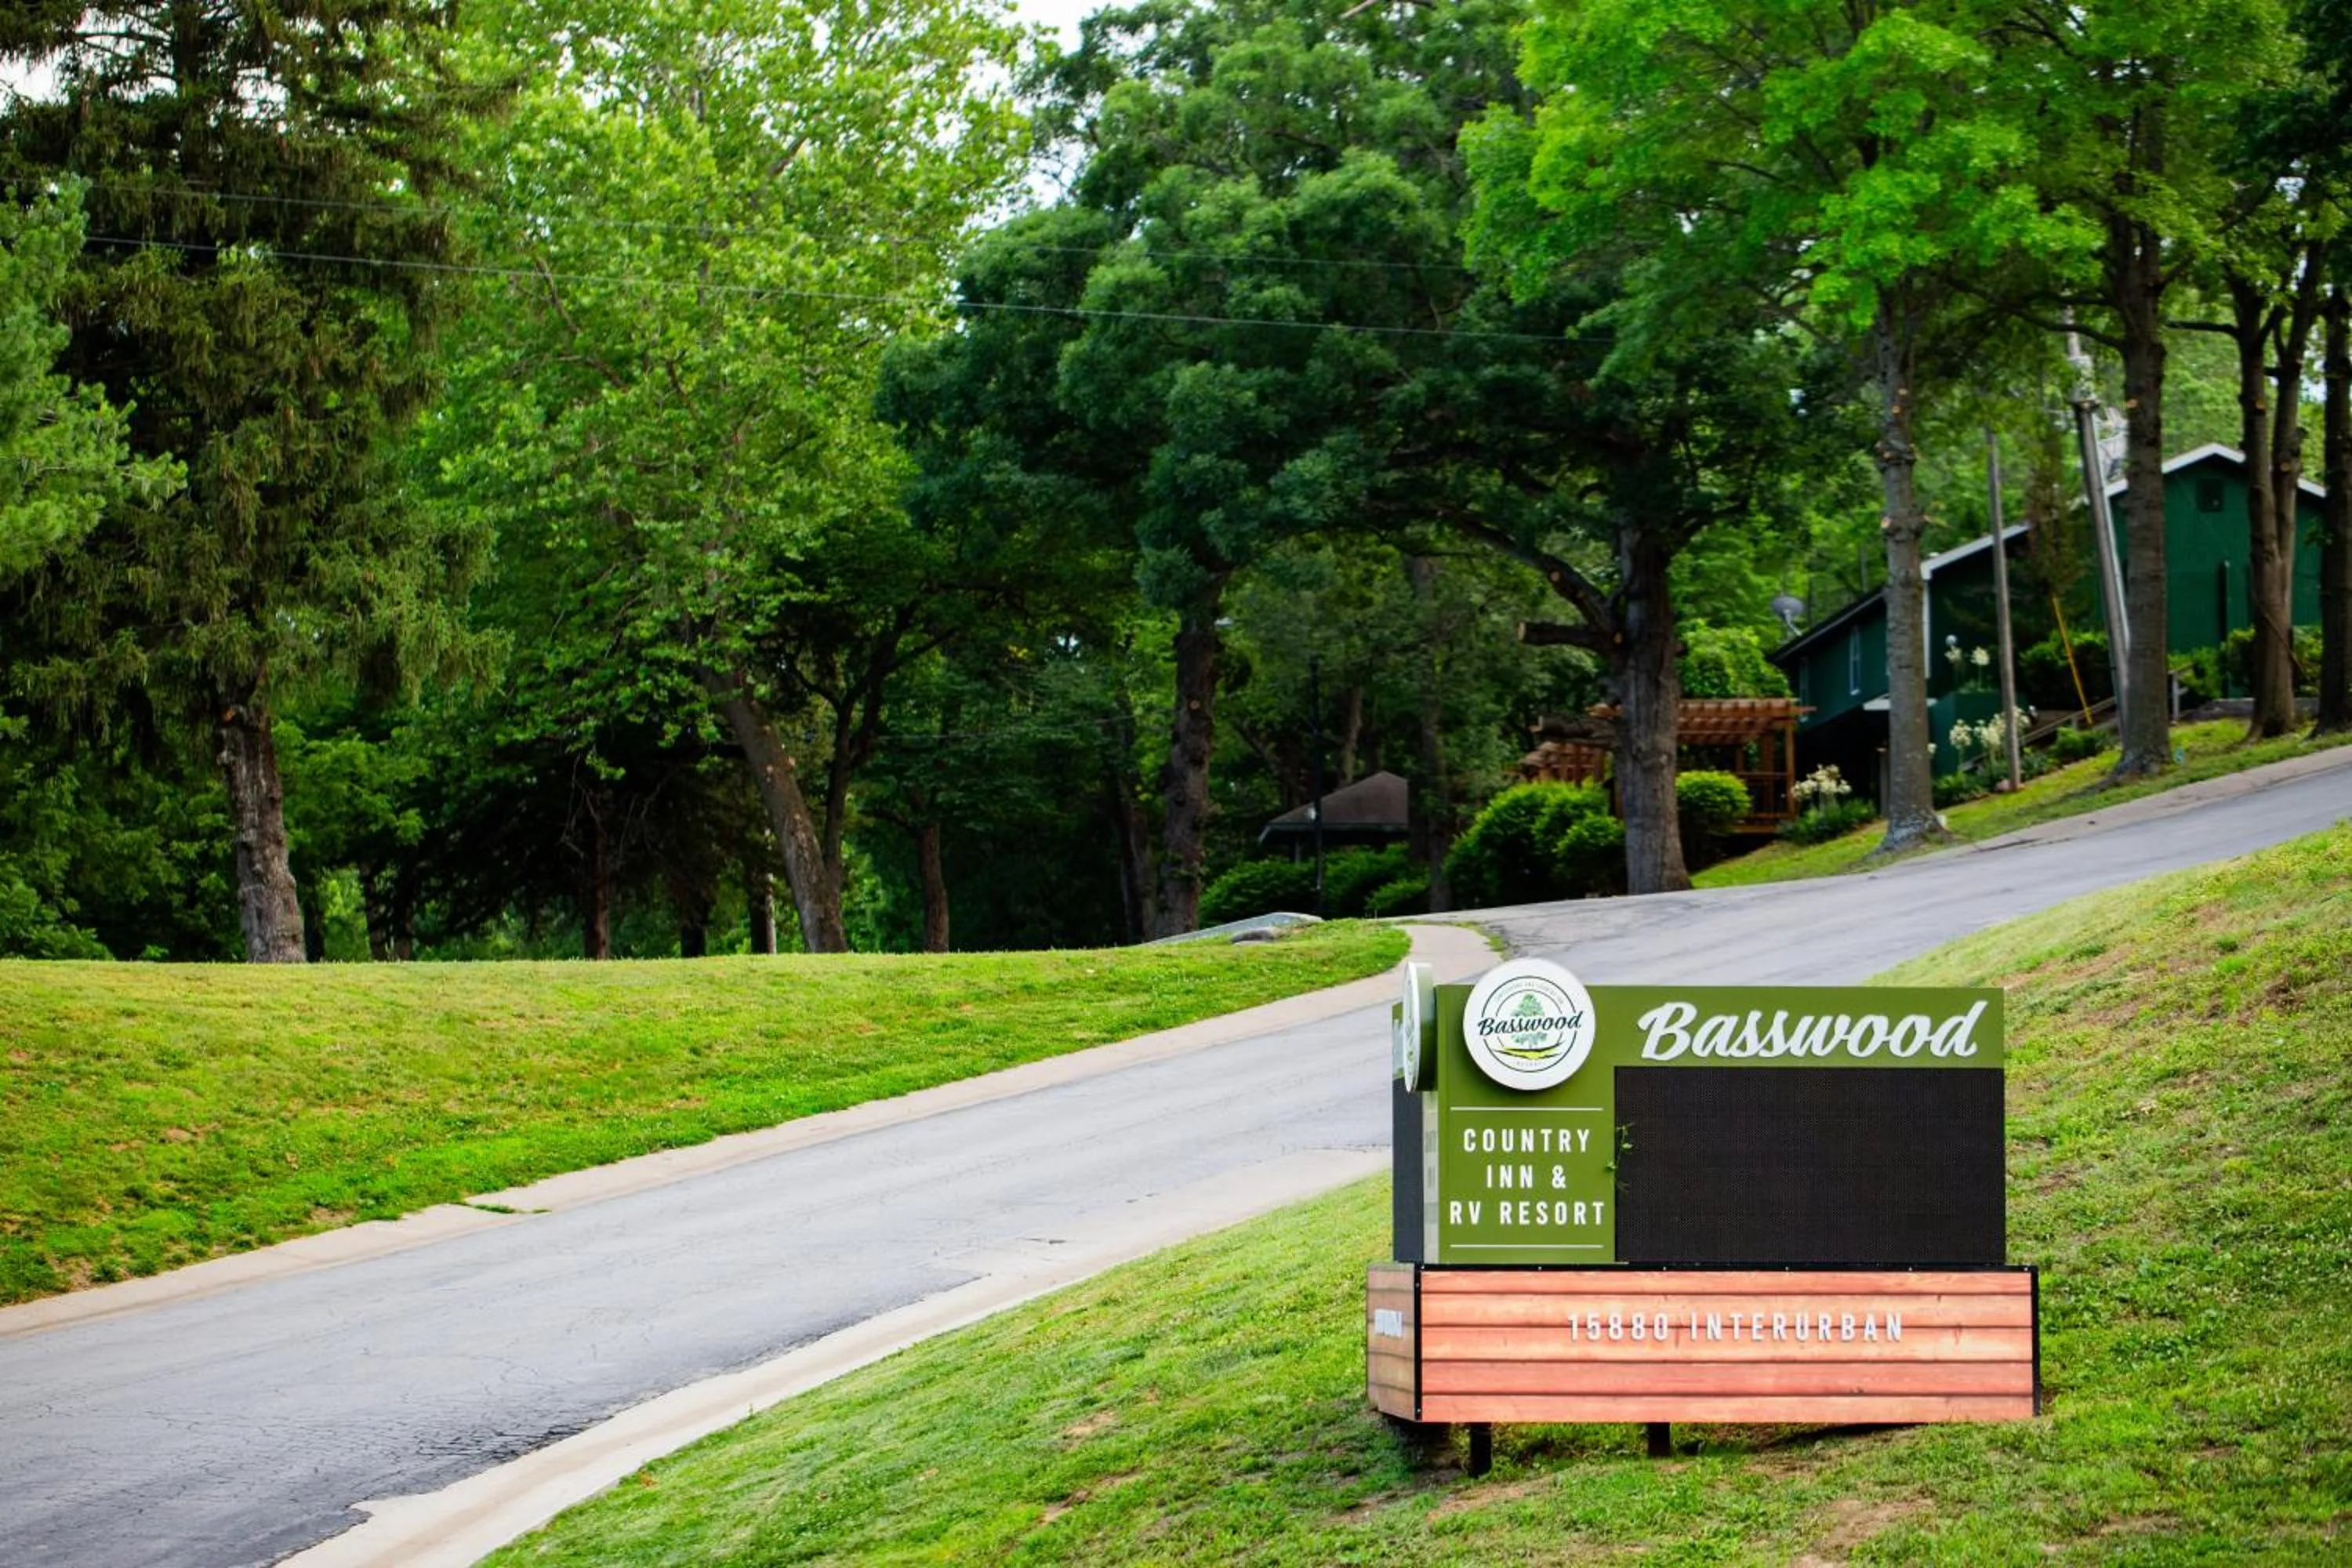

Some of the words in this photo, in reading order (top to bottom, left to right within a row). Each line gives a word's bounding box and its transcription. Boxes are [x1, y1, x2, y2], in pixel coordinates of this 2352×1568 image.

[1477, 1011, 1584, 1036] Basswood
[1637, 1000, 1987, 1061] Basswood
[1464, 1128, 1590, 1152] COUNTRY
[1486, 1165, 1534, 1188] INN
[1552, 1165, 1566, 1189] &
[1450, 1201, 1481, 1225] RV
[1500, 1201, 1605, 1225] RESORT
[1568, 1312, 1668, 1341] 15880
[1690, 1312, 1902, 1341] INTERURBAN
